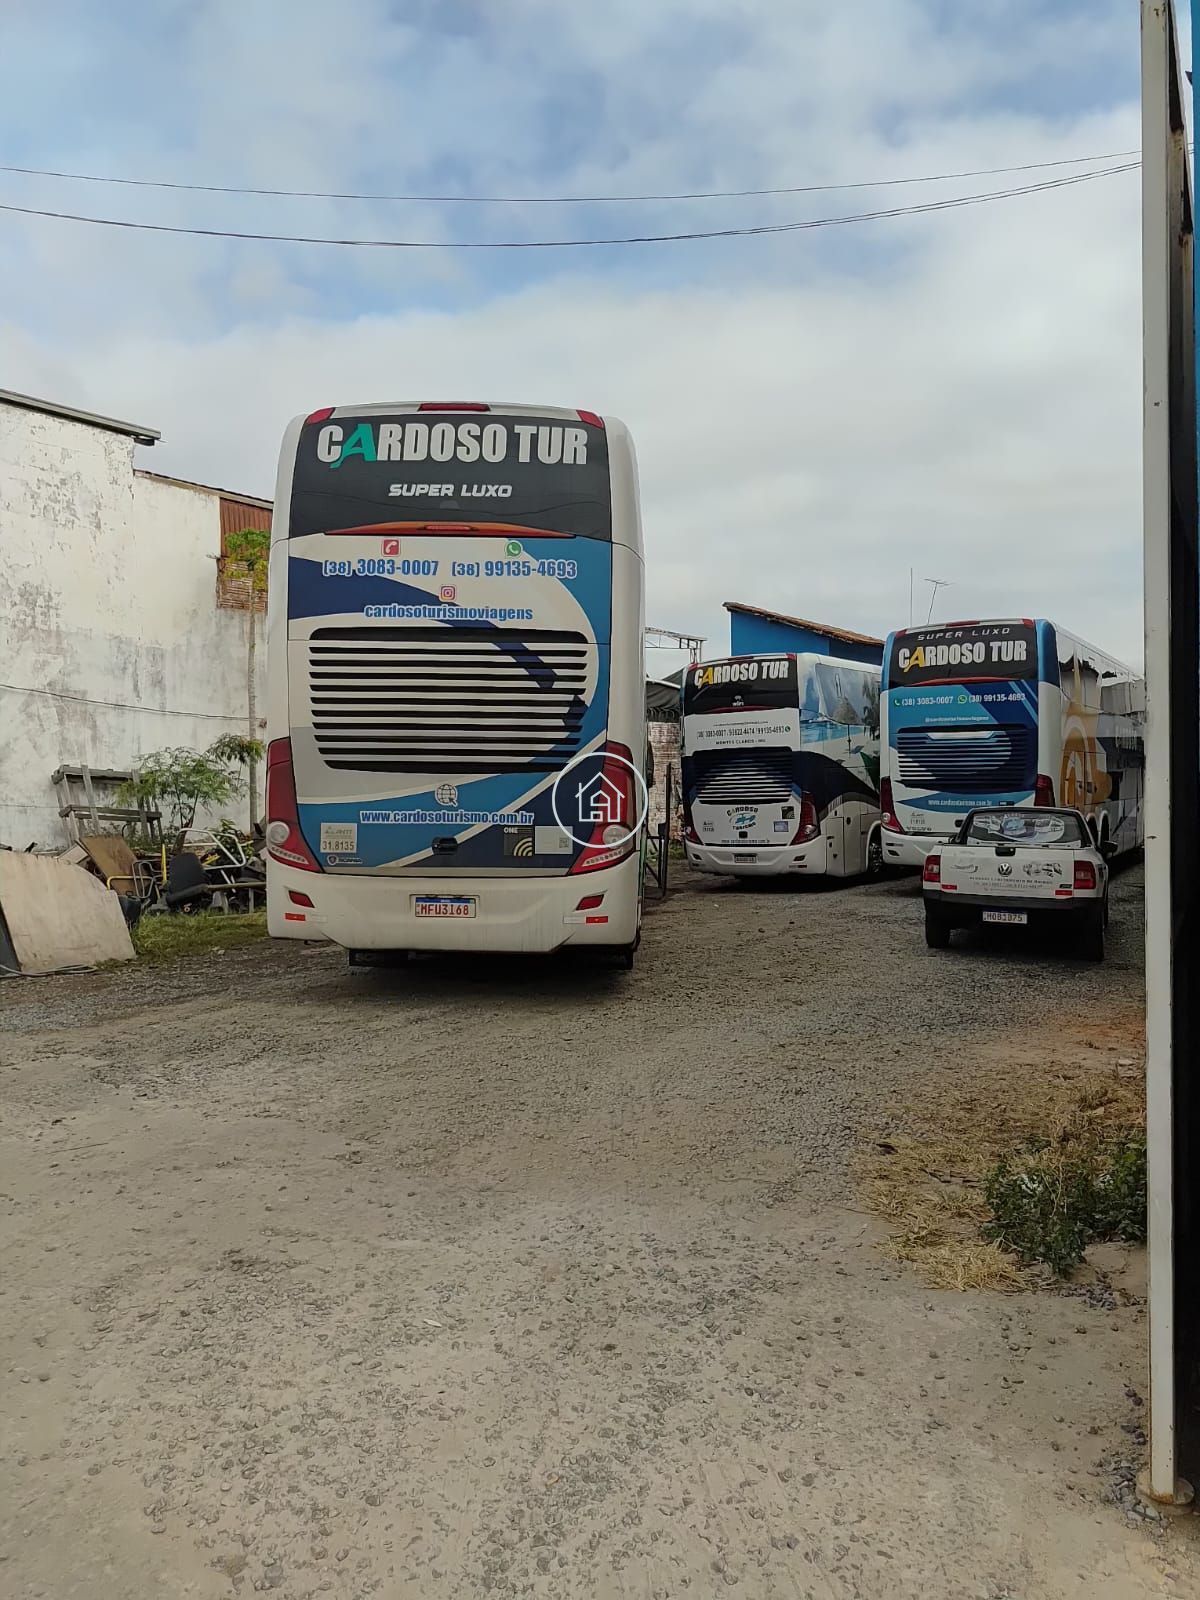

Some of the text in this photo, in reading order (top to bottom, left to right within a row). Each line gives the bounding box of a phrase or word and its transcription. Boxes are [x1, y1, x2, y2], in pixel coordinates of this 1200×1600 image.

[317, 423, 588, 468] CARDOSO TUR
[388, 483, 513, 498] SUPER LUXO
[322, 559, 578, 579] (38) 3083-0007 (38) 99135-4693
[364, 603, 533, 621] cardosoturismoviagens
[918, 627, 1011, 642] SUPER LUXO
[898, 640, 1027, 673] CARDOSO TUR
[694, 660, 789, 689] CARDOSO TUR
[359, 809, 535, 826] www.cardosoturismo.com.br
